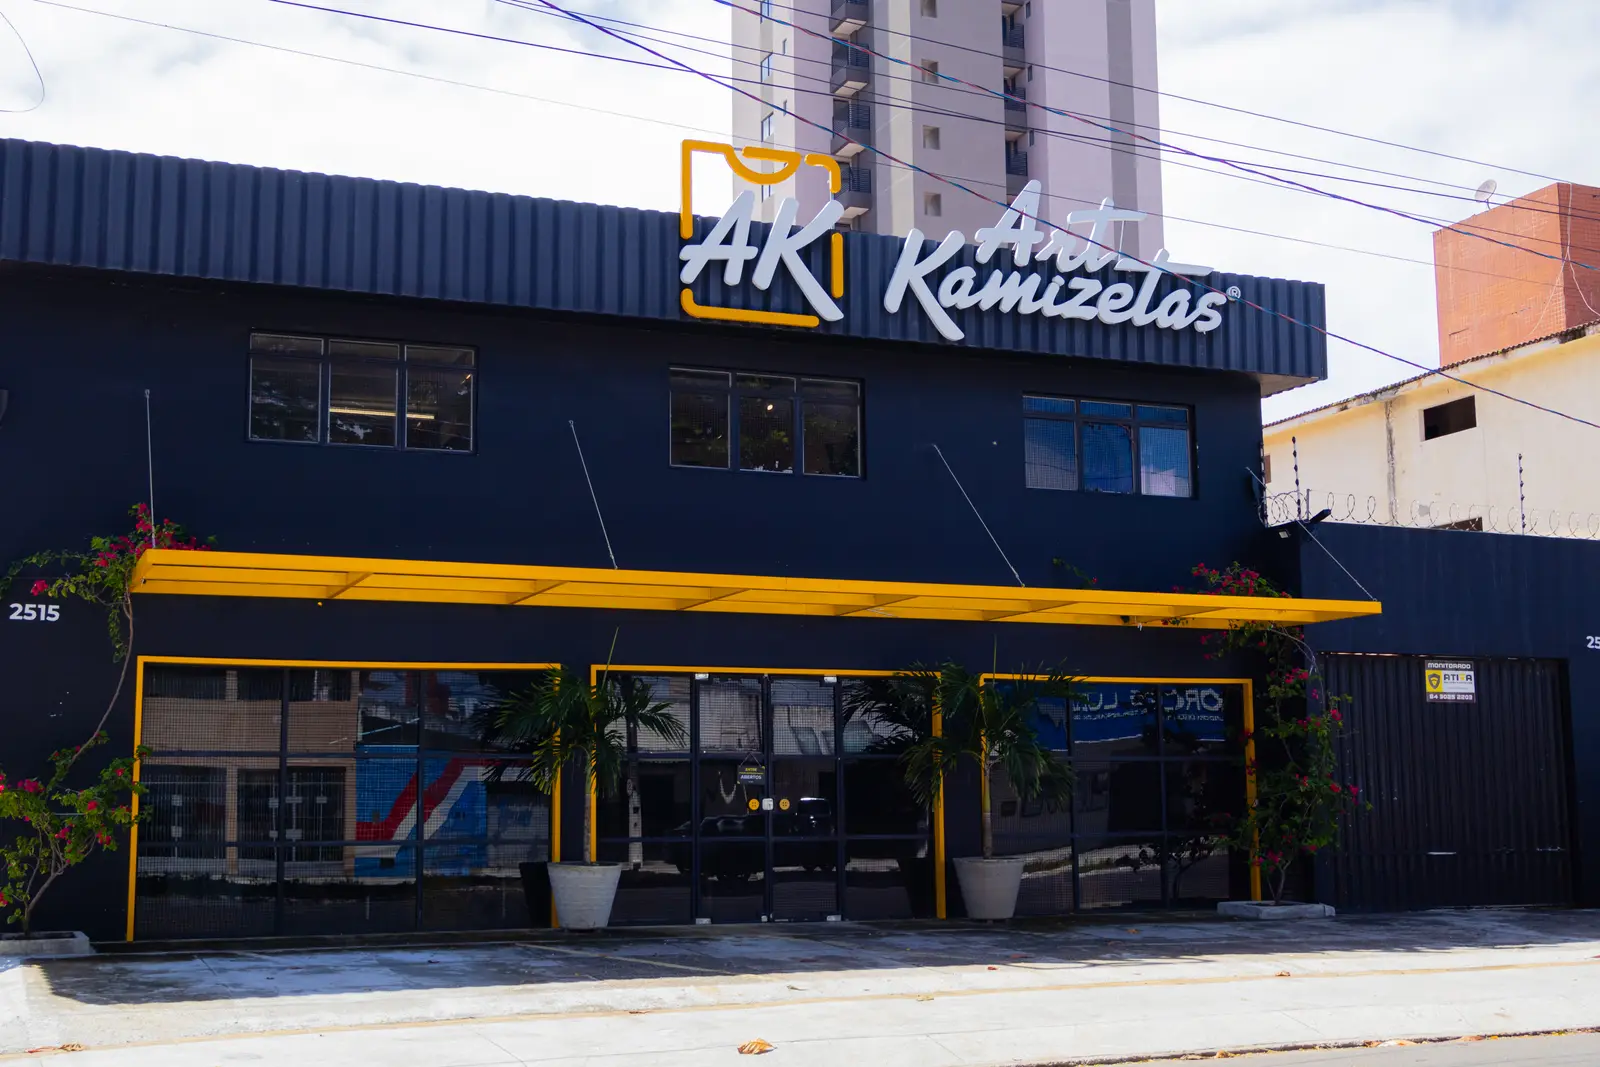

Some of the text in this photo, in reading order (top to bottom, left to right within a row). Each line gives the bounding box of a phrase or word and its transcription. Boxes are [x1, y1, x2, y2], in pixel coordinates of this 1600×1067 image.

[680, 190, 844, 322] AK
[974, 179, 1147, 274] Art
[884, 228, 1228, 342] Kamizetas
[9, 603, 60, 621] 2515
